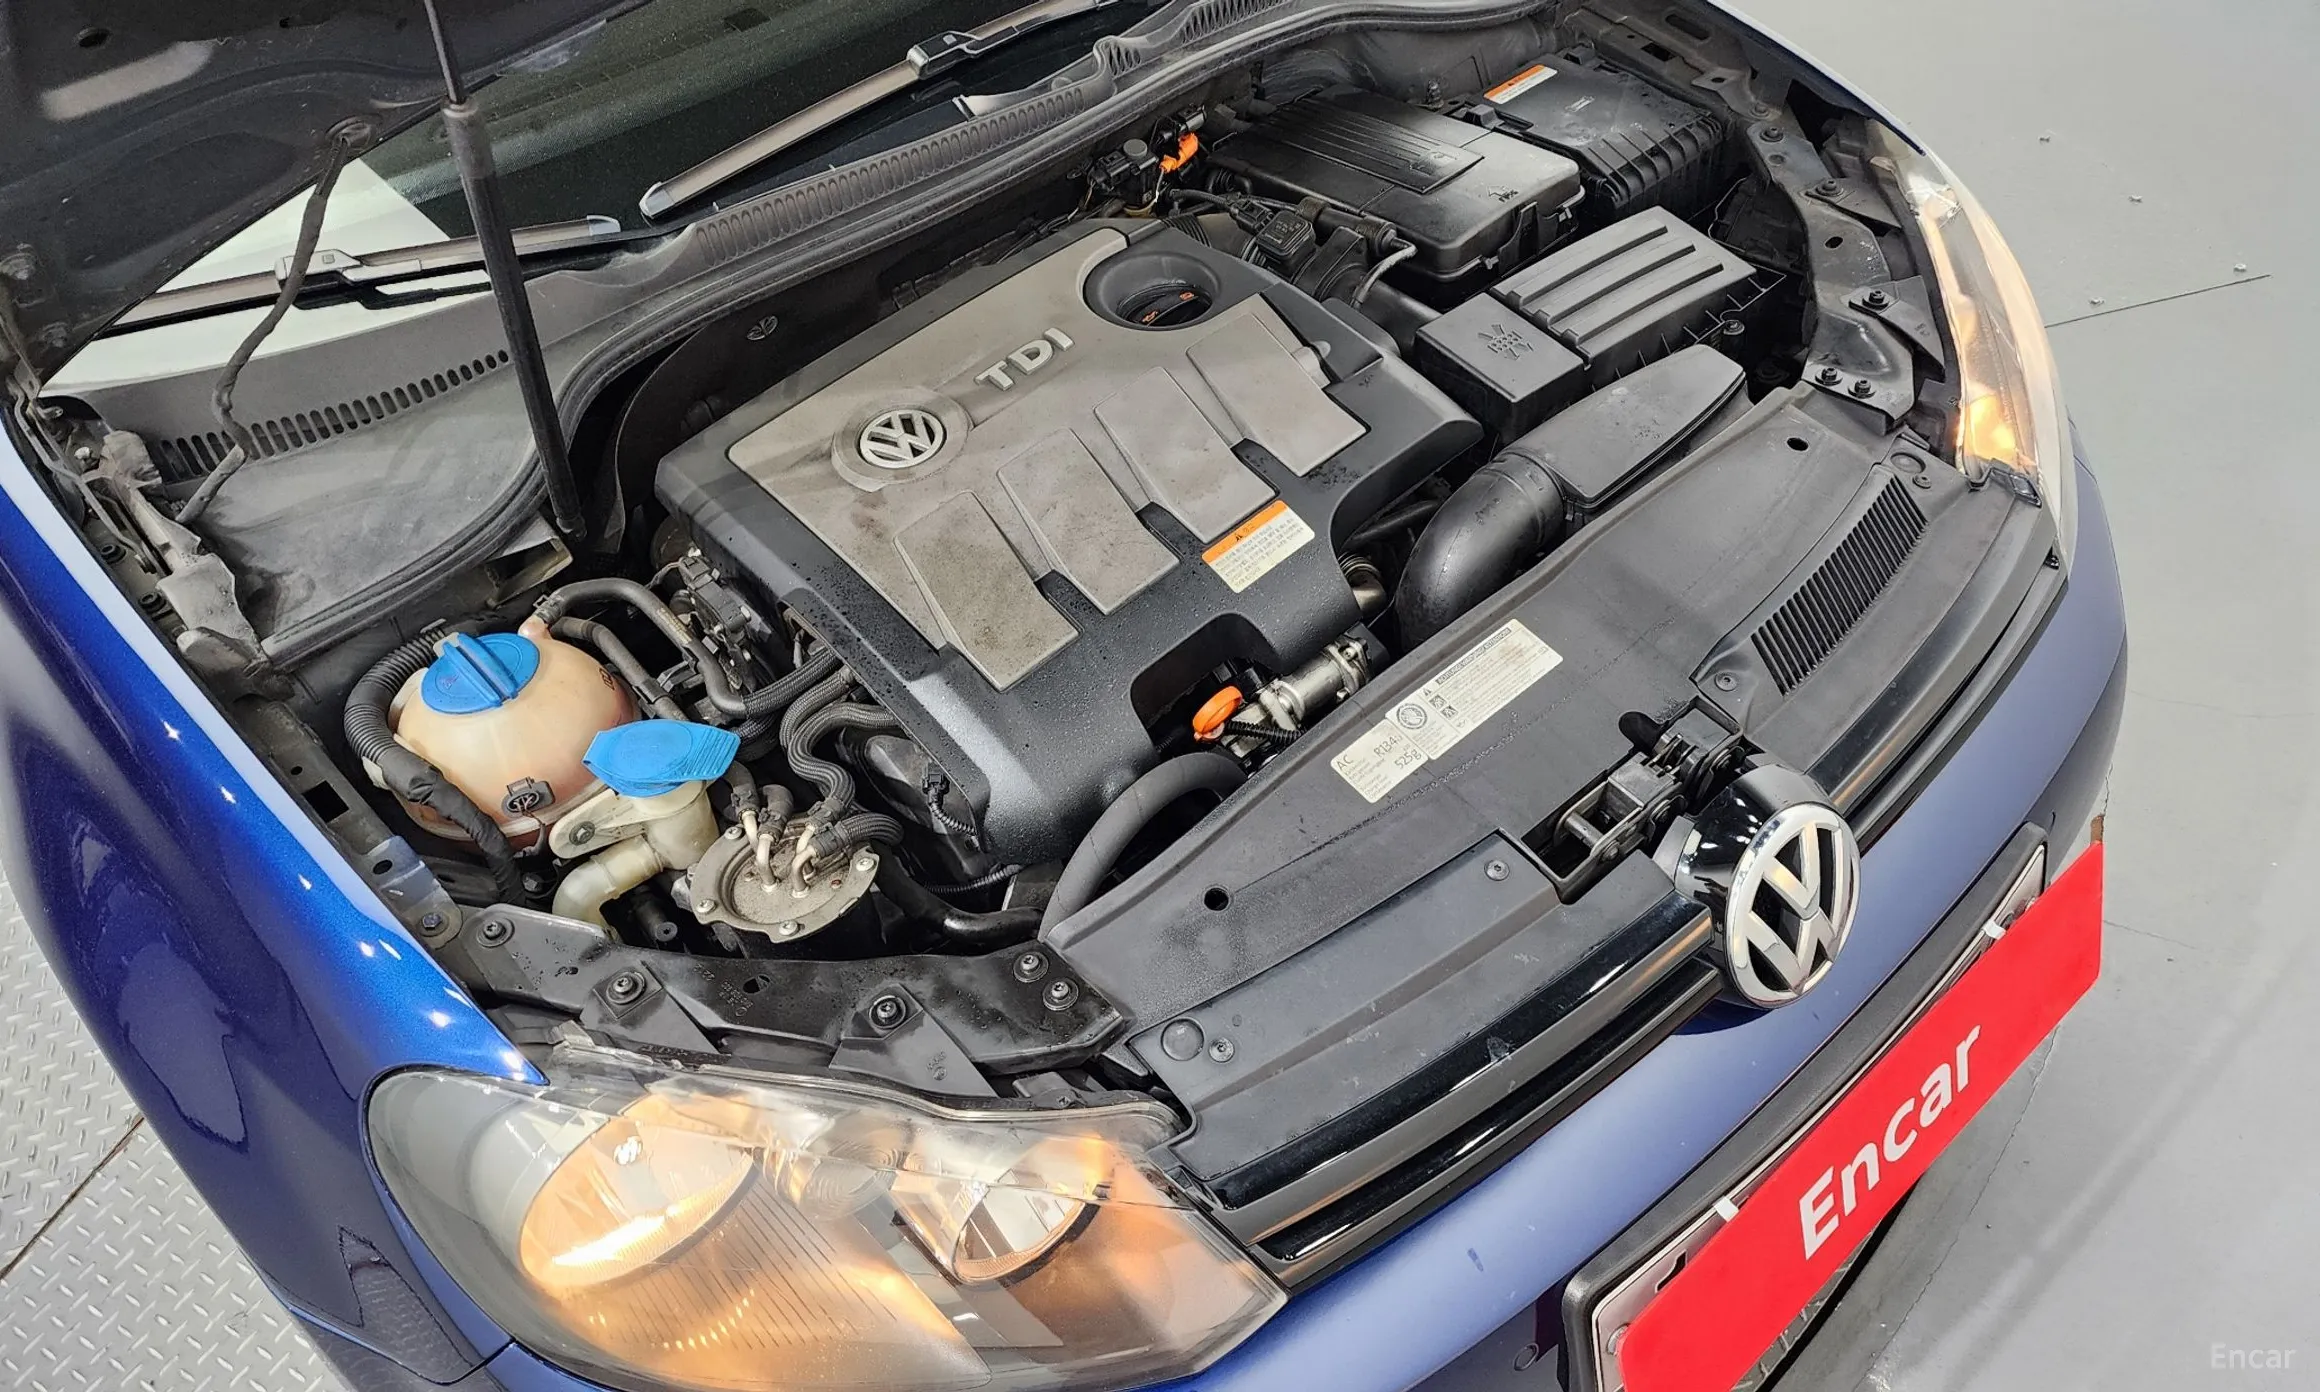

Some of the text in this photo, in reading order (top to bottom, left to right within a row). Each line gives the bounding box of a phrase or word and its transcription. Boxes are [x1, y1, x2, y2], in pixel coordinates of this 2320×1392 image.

[974, 328, 1075, 390] TDI
[1337, 754, 1353, 771] AC
[1394, 749, 1422, 769] 525g
[1799, 1024, 1981, 1261] Encar
